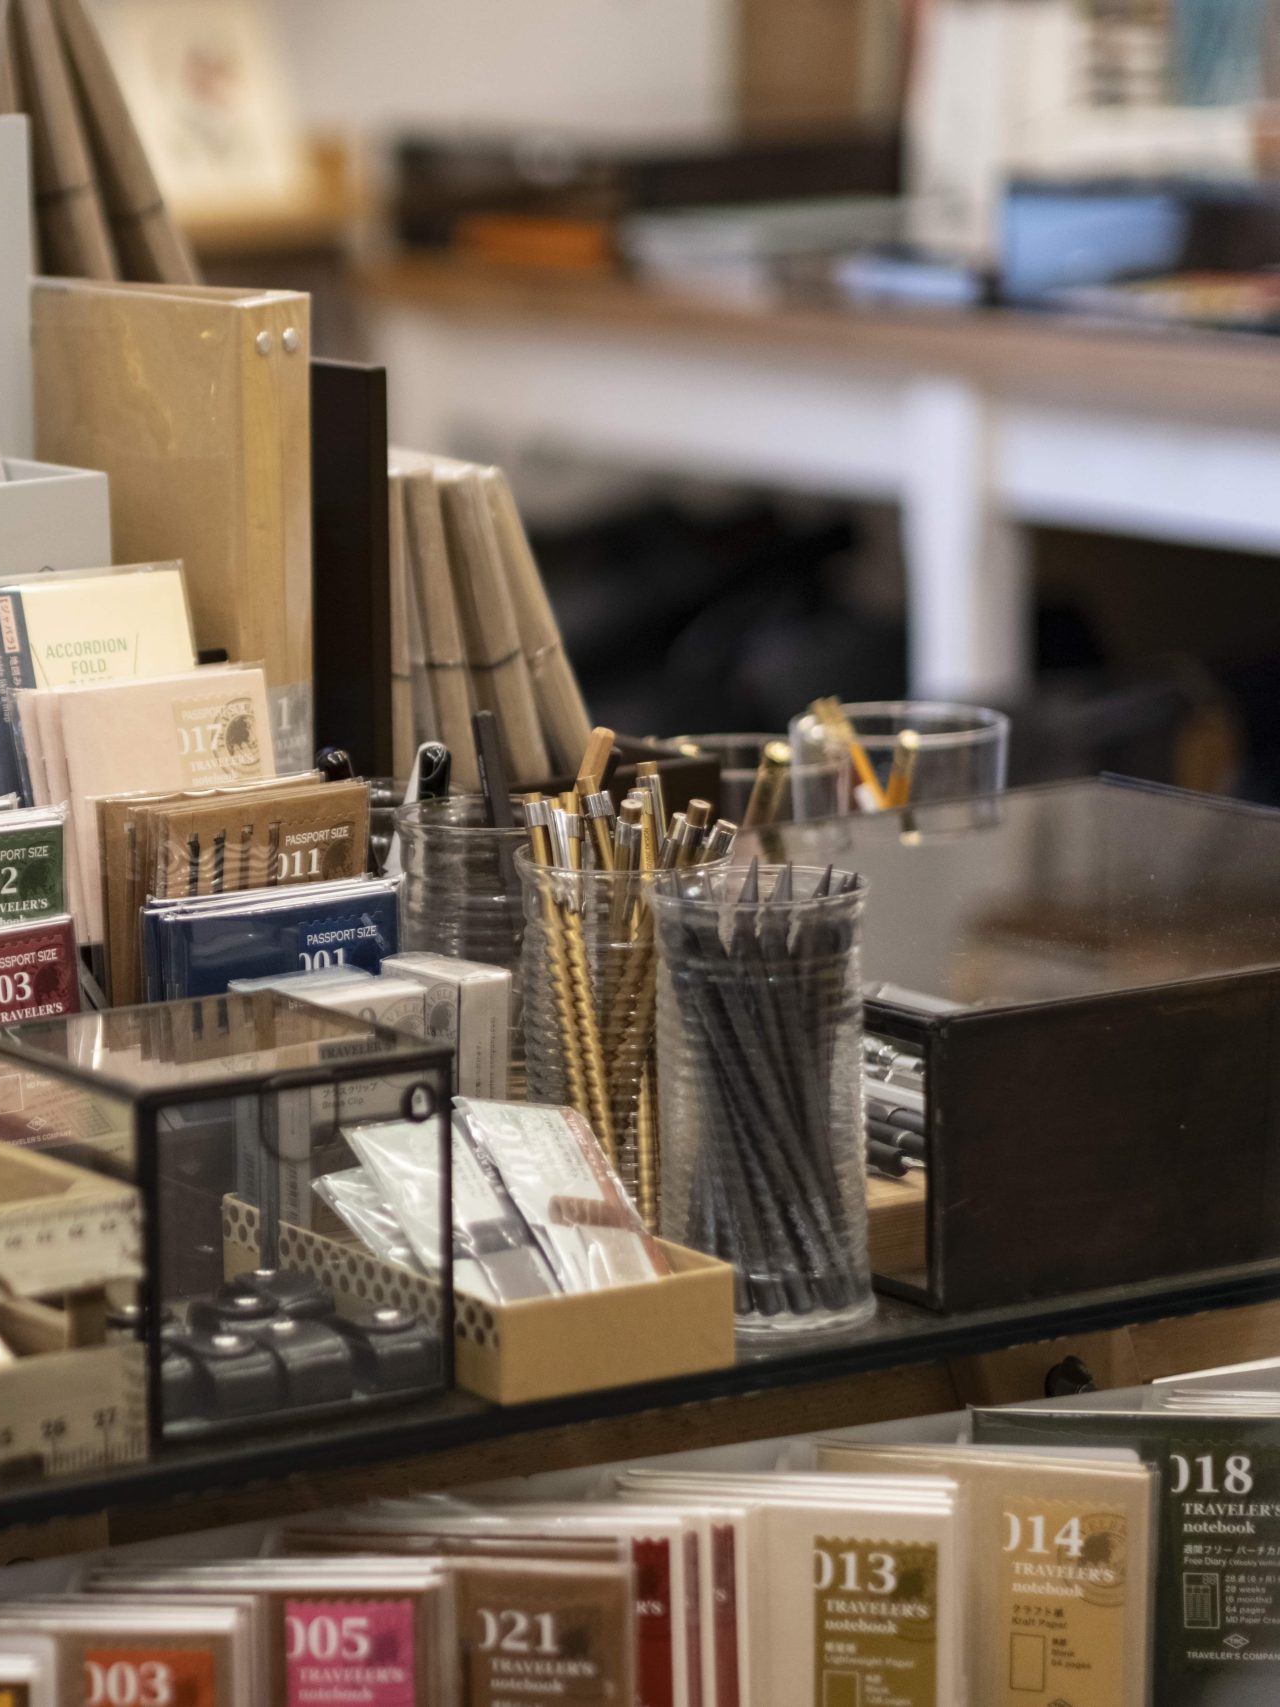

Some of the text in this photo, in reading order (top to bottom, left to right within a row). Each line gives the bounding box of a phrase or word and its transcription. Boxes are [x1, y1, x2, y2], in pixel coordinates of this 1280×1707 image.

[46, 638, 128, 659] ACCORDION
[71, 659, 107, 675] FOLD
[285, 825, 349, 846] PASSPORT SIZE
[28, 845, 49, 859] SIZE
[307, 925, 377, 945] PASSPORT SIZE
[38, 948, 58, 962] SIZE
[1183, 1502, 1280, 1518] TRAVELER'S
[1183, 1520, 1256, 1535] notebook
[1184, 1557, 1204, 1566] Free
[1205, 1557, 1227, 1569] Diary
[1013, 1563, 1116, 1583] TRAVELER'S
[1012, 1581, 1084, 1598] notebook
[825, 1599, 929, 1619] TRAVELER'S
[825, 1618, 899, 1636] notebook
[1187, 1651, 1241, 1661] TRAVELER'S
[299, 1667, 405, 1683] TRAVELER'S
[491, 1658, 597, 1678] TRAVELER'S
[491, 1677, 565, 1694] notebook
